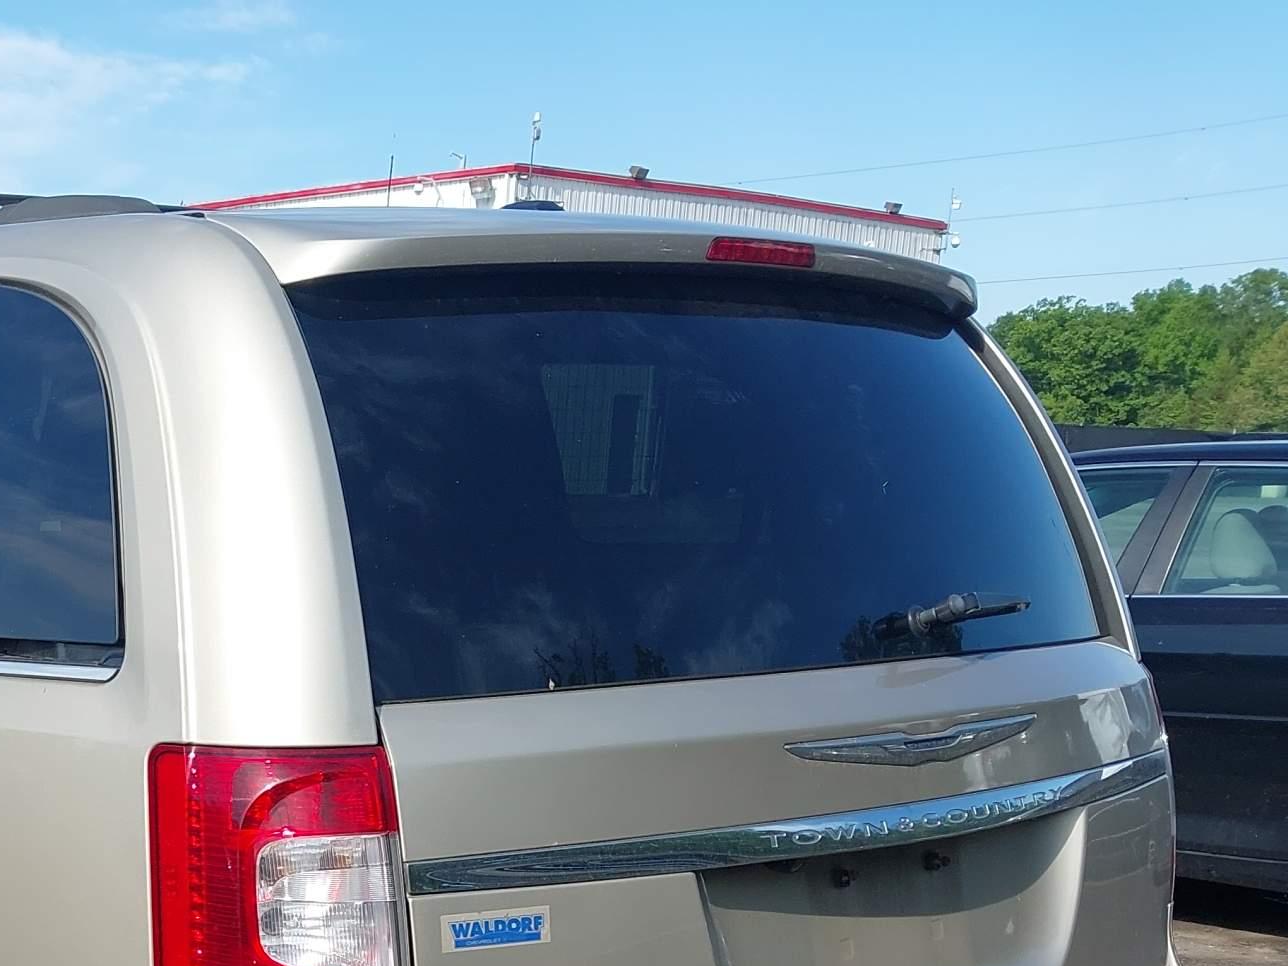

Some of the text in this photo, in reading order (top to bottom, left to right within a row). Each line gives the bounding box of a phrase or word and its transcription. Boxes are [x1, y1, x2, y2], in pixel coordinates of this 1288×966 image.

[760, 785, 1065, 848] TOWN & COUNTRY
[450, 914, 544, 938] WALDORF
